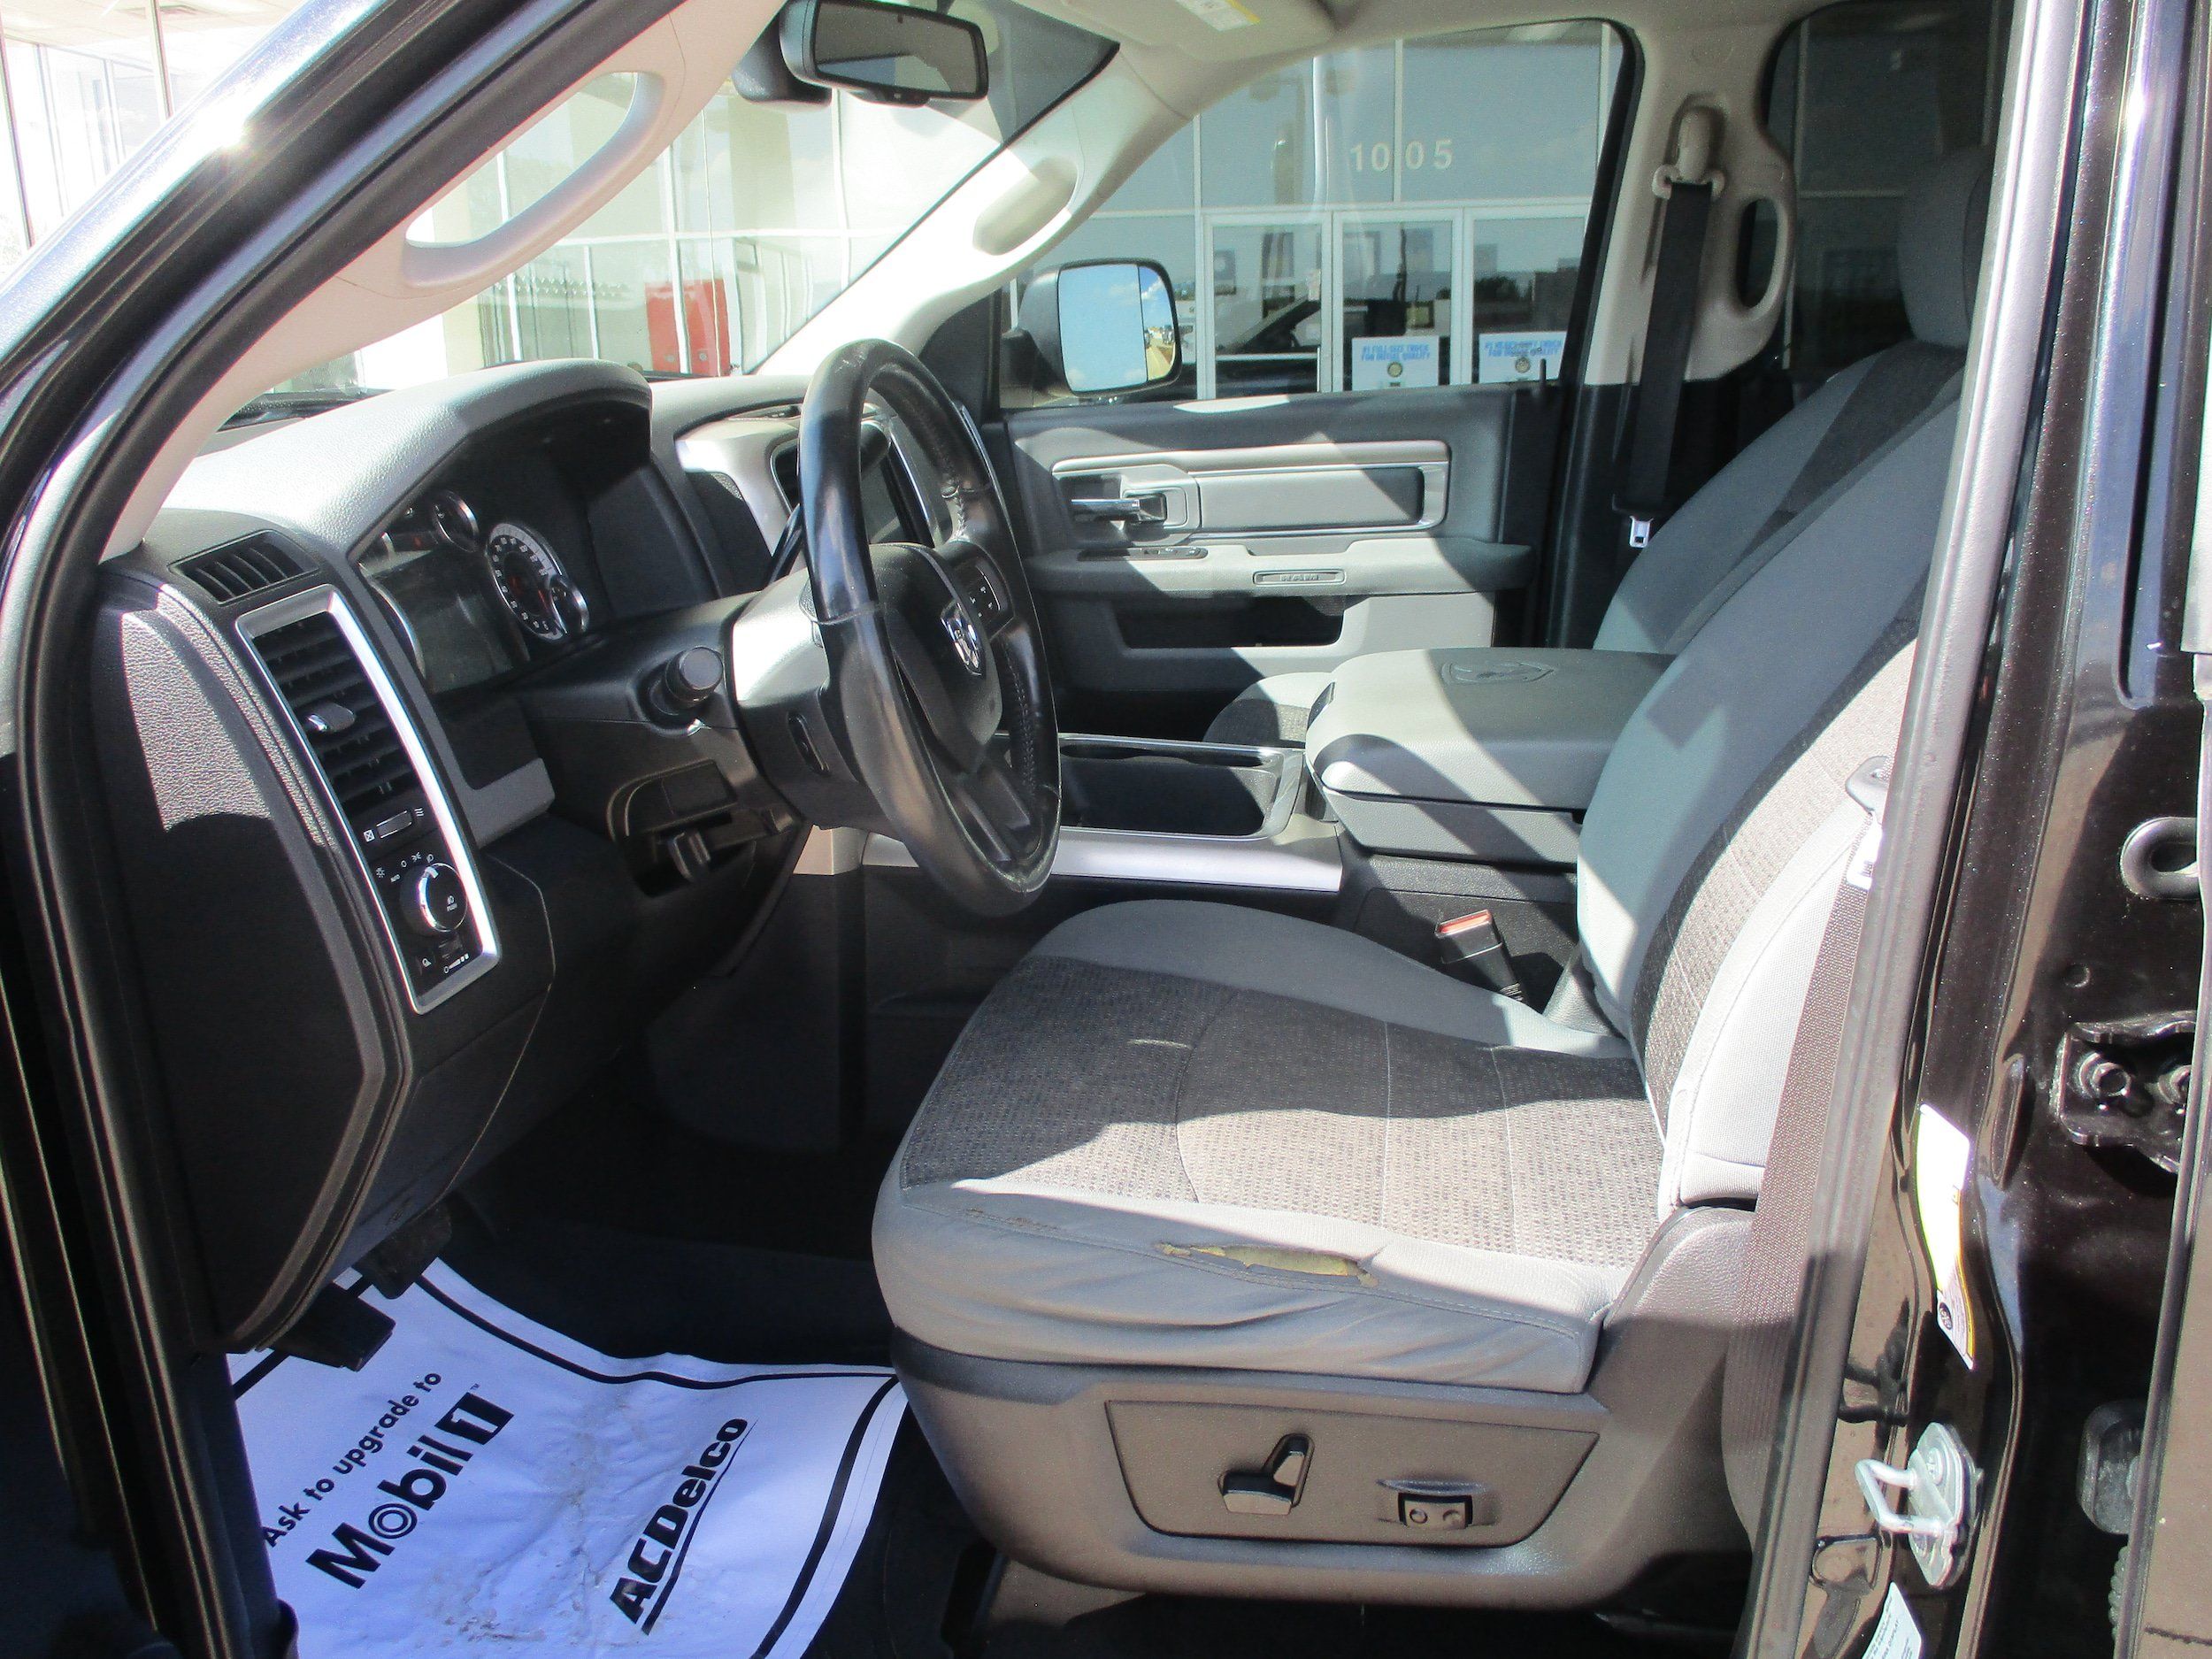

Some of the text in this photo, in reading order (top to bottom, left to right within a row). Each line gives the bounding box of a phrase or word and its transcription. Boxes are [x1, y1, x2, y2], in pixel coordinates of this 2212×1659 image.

[1350, 139, 1453, 171] 1005
[263, 1372, 442, 1548] Ask to upgrade to
[305, 1434, 473, 1589] Mobil
[610, 1418, 748, 1624] ACDelco
